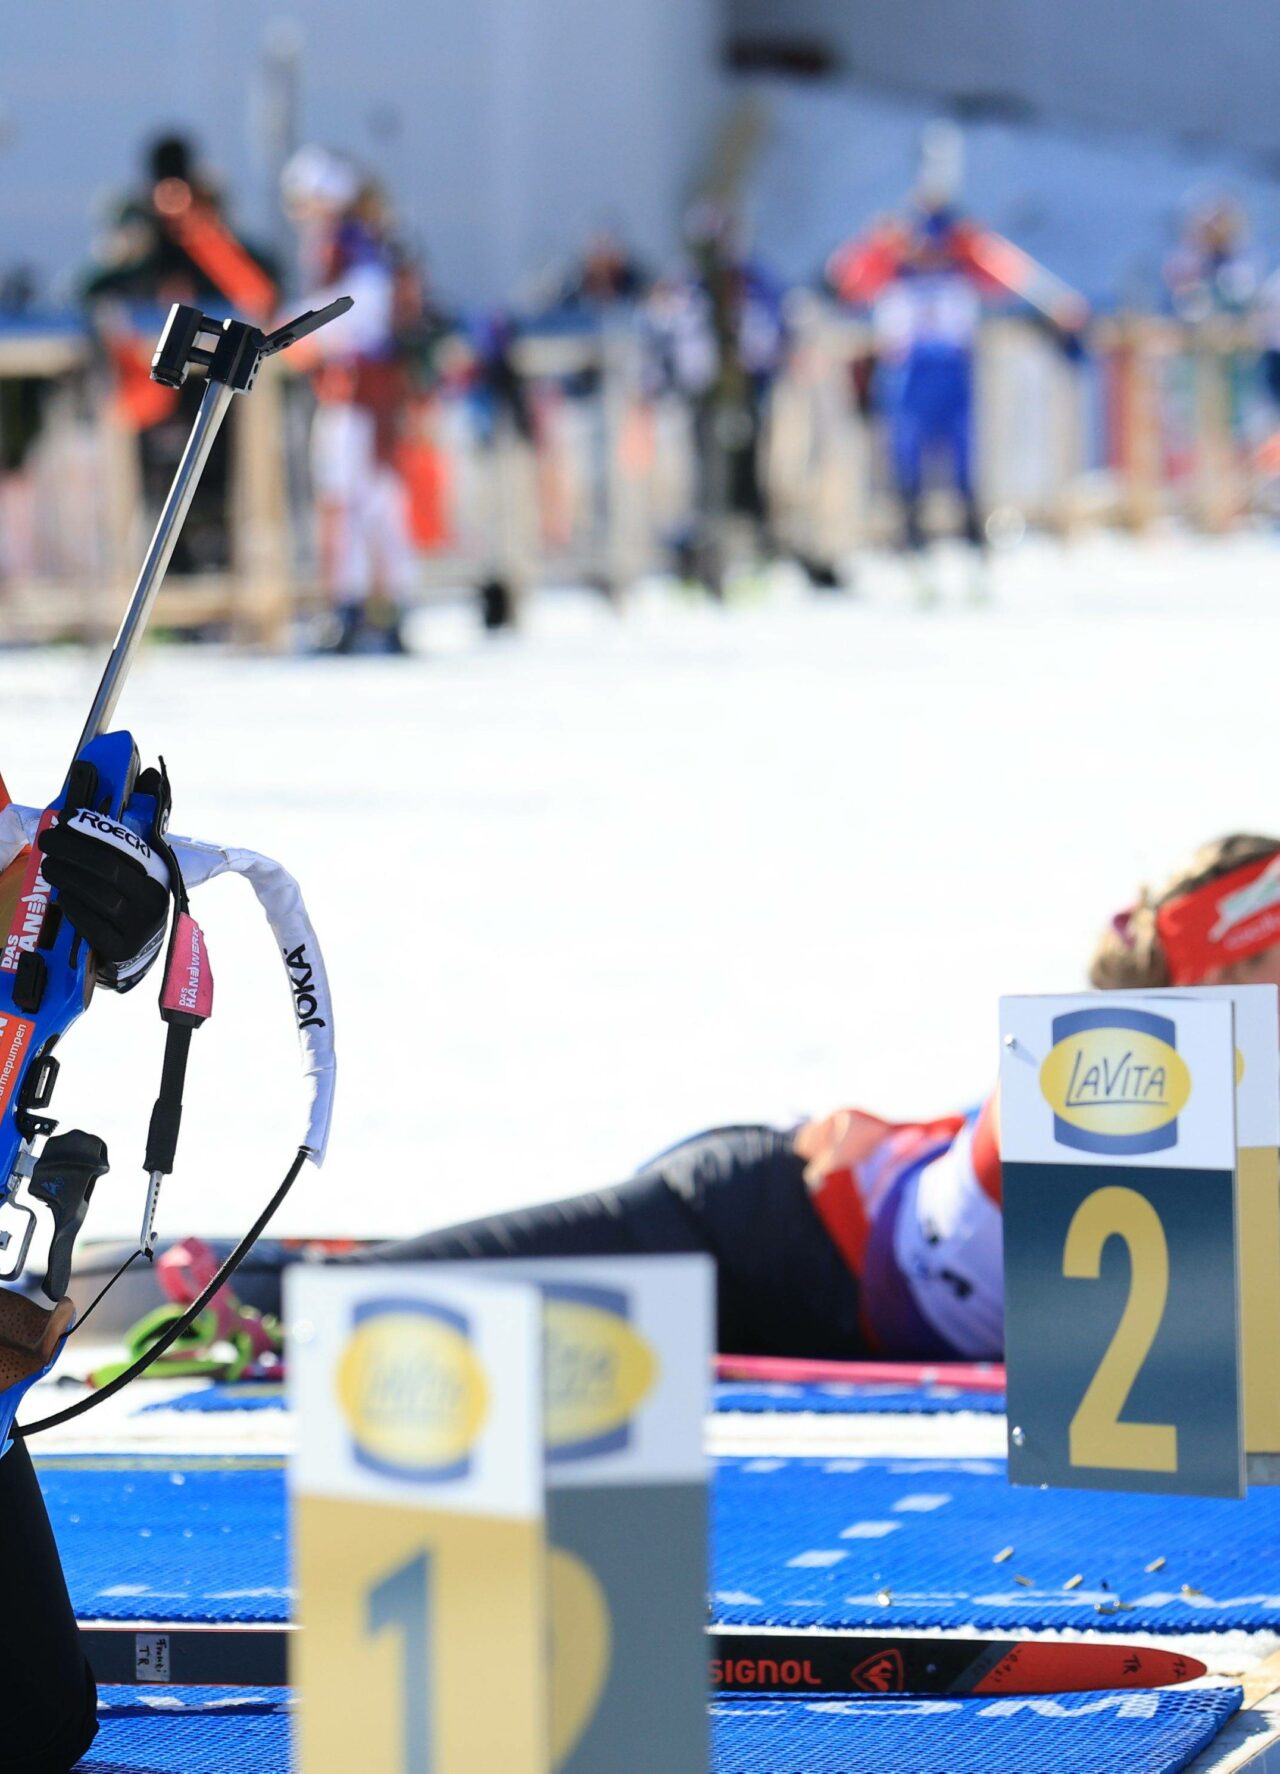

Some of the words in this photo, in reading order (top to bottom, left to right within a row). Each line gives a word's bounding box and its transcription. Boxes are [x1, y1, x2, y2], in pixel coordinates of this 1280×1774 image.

[1, 935, 19, 969] DAS
[286, 944, 326, 1030] JOKA
[1062, 1185, 1178, 1472] 2
[362, 1542, 436, 1774] 1
